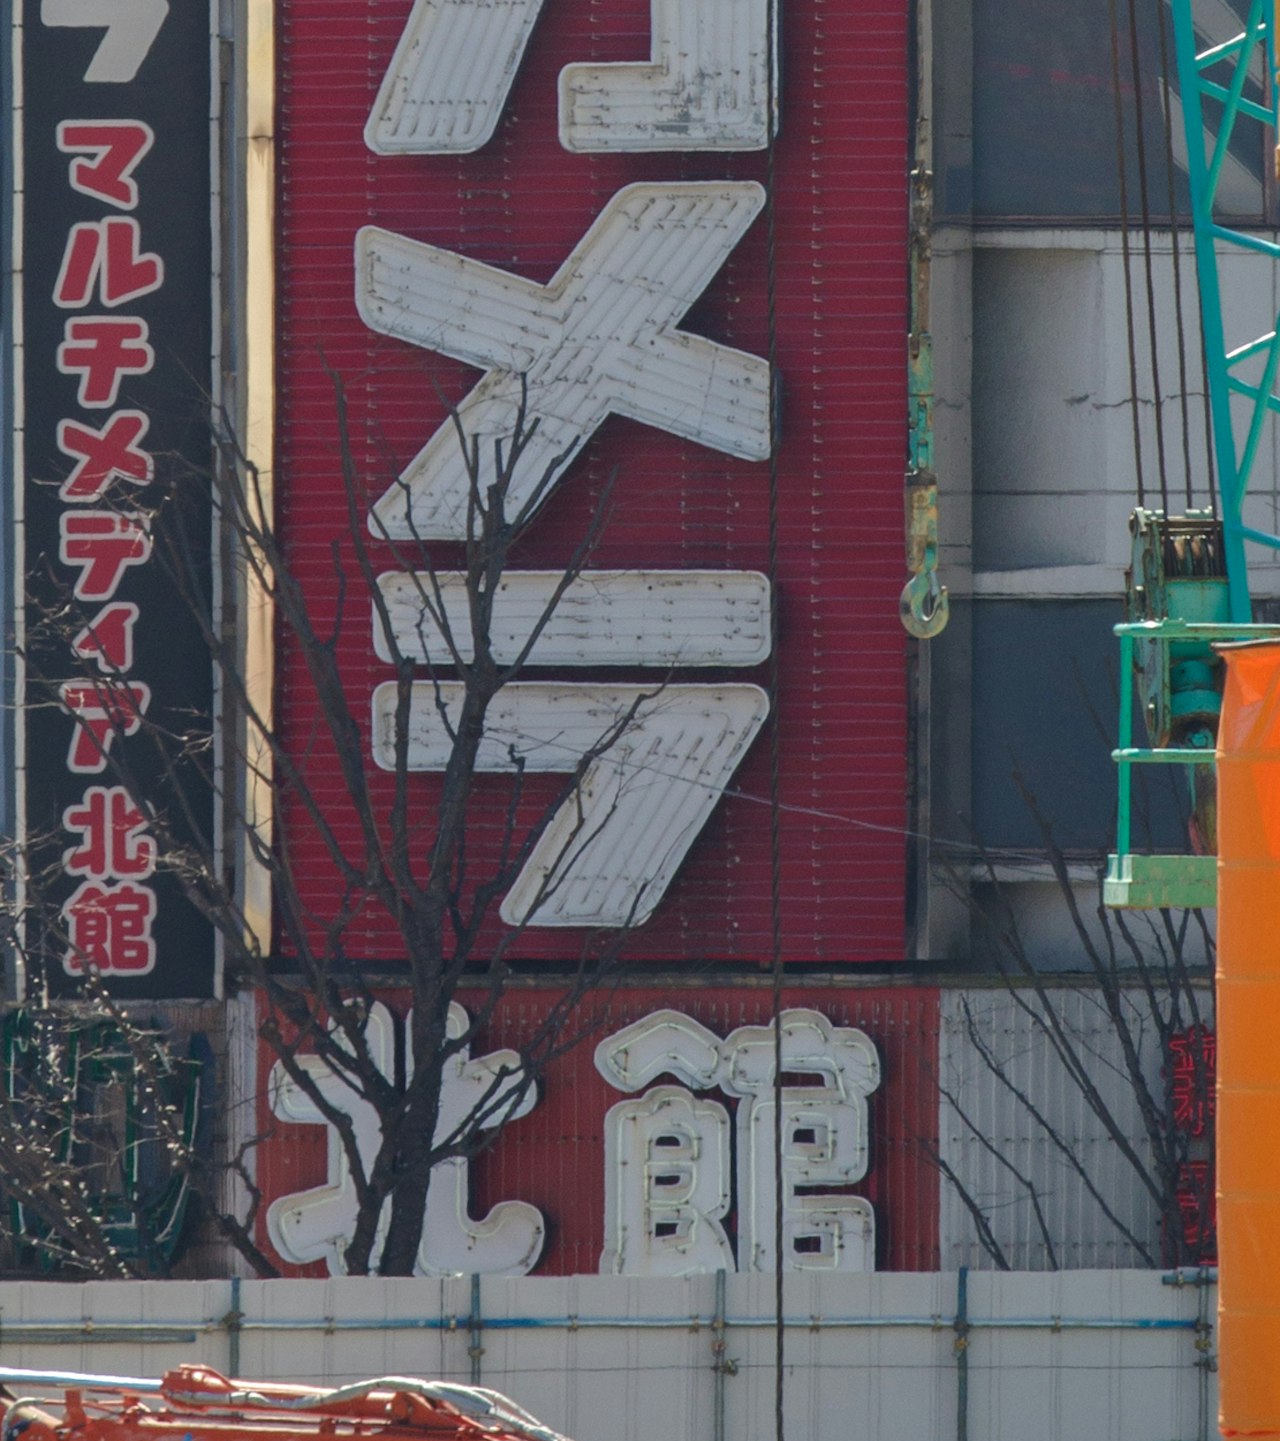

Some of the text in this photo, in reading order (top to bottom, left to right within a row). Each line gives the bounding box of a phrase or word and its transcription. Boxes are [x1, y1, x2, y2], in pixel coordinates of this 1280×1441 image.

[53, 120, 166, 977] マルチメディア北館
[266, 998, 881, 1278] 北館
